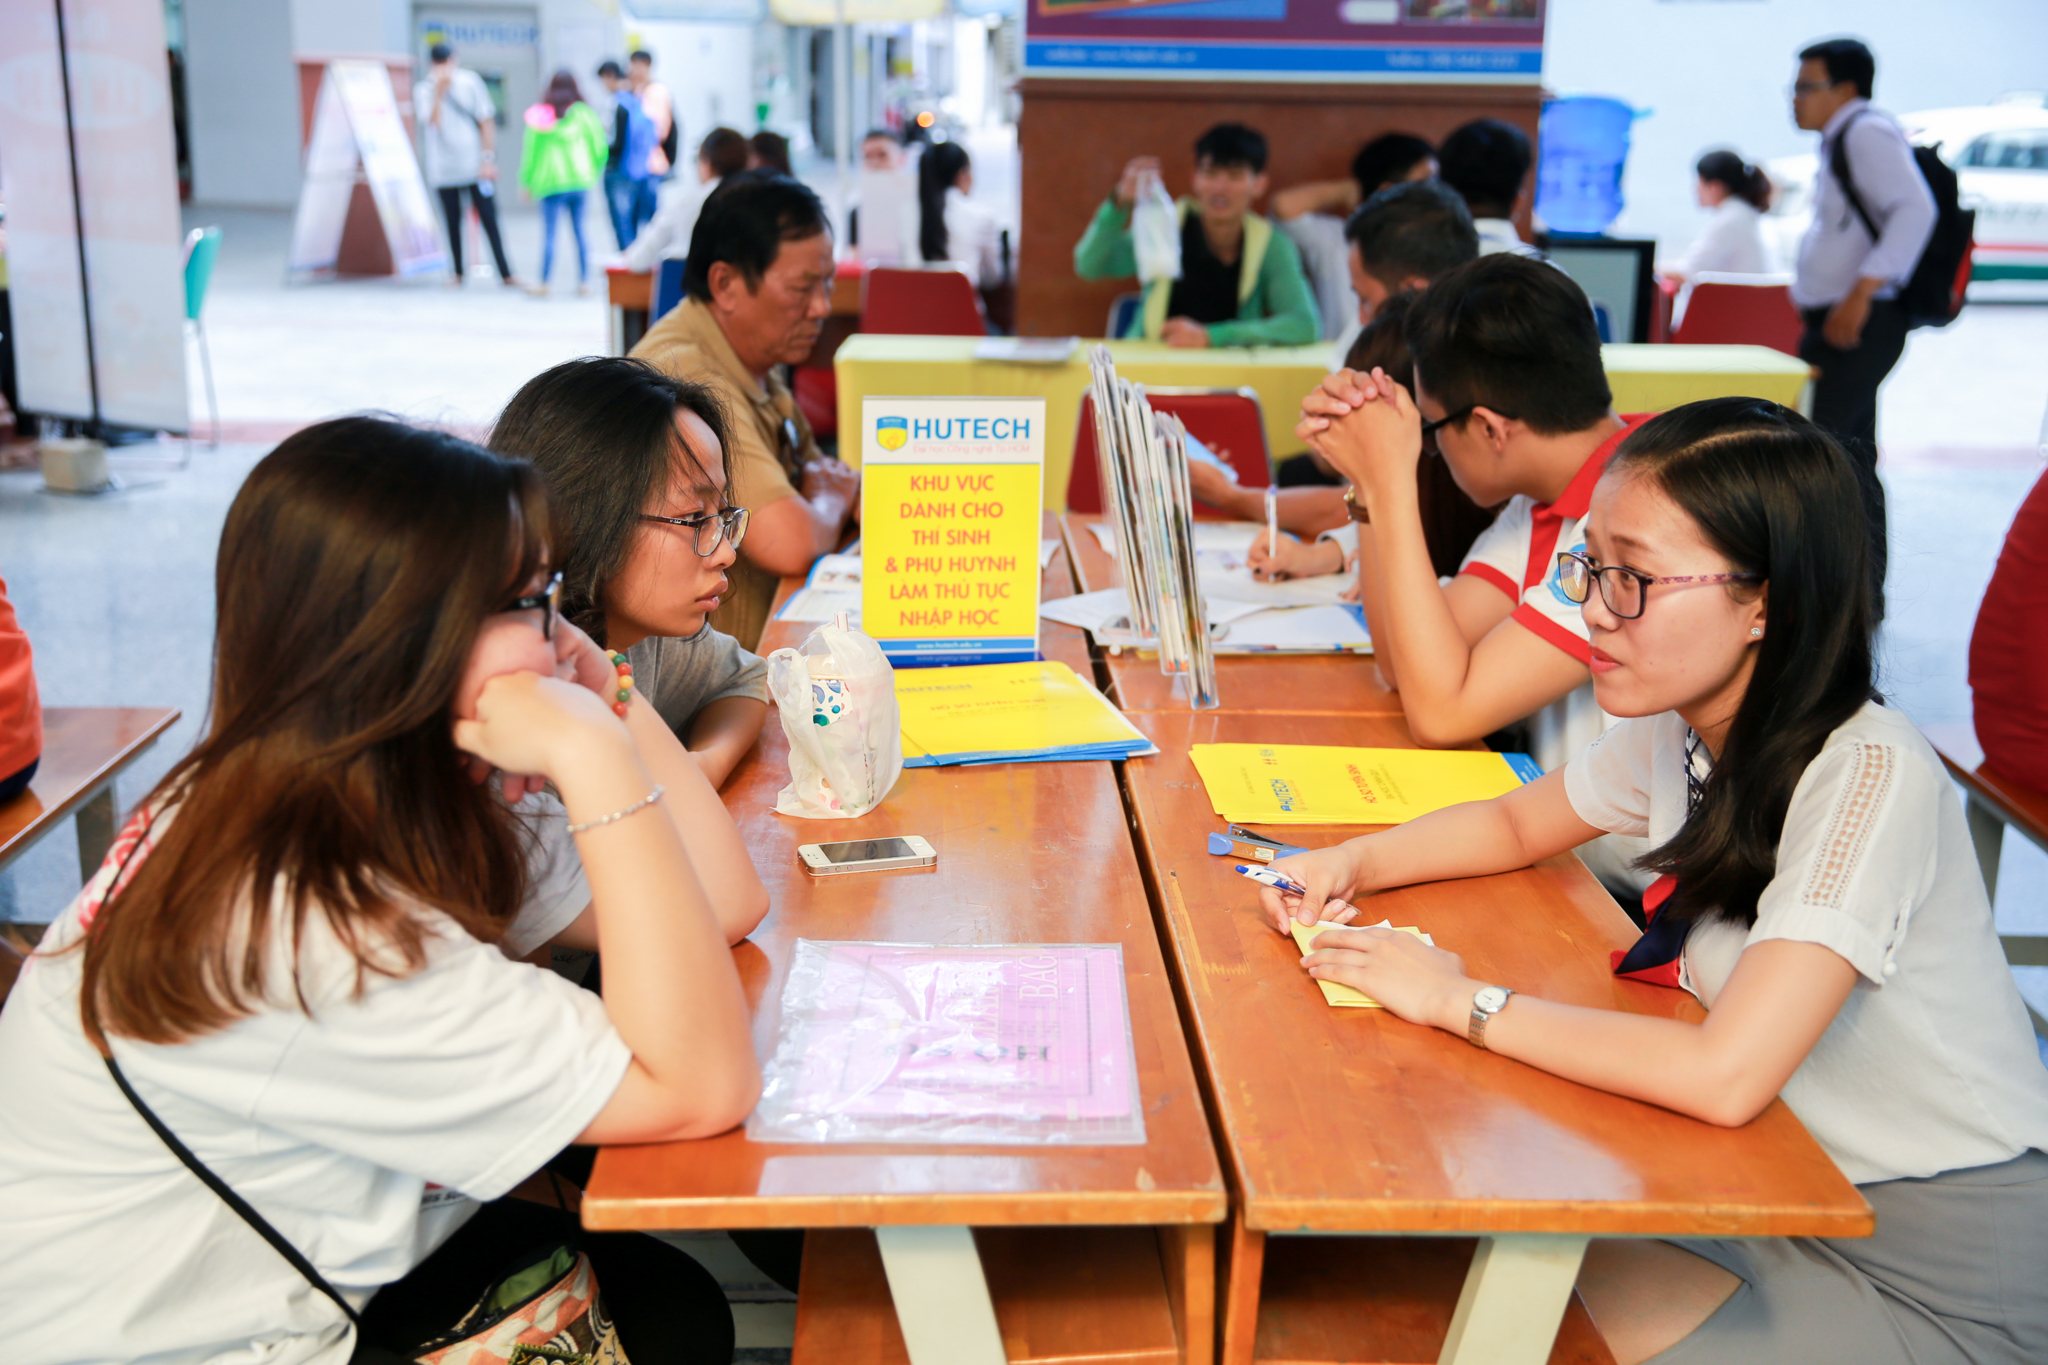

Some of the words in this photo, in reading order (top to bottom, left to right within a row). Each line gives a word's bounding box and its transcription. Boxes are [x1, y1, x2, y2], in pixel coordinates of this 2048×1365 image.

[914, 418, 1030, 439] HUTECH
[910, 475, 950, 491] KHU
[956, 474, 995, 496] VỰC
[900, 498, 956, 519] DÀNH
[962, 502, 1004, 519] CHO
[912, 525, 941, 546] THÍ
[946, 529, 990, 546] SINH
[885, 557, 899, 574] &
[905, 556, 942, 577] PHỤ
[949, 556, 1016, 572] HUYNH
[890, 579, 928, 600] LÀM
[935, 578, 970, 599] THỦ
[976, 582, 1010, 602] TỤC
[900, 606, 952, 630] NHẬP
[959, 609, 999, 629] HỌC
[916, 641, 982, 650] www.hutech.edu.vn
[1269, 778, 1296, 805] HUTECH
[1018, 955, 1059, 1000] BAG
